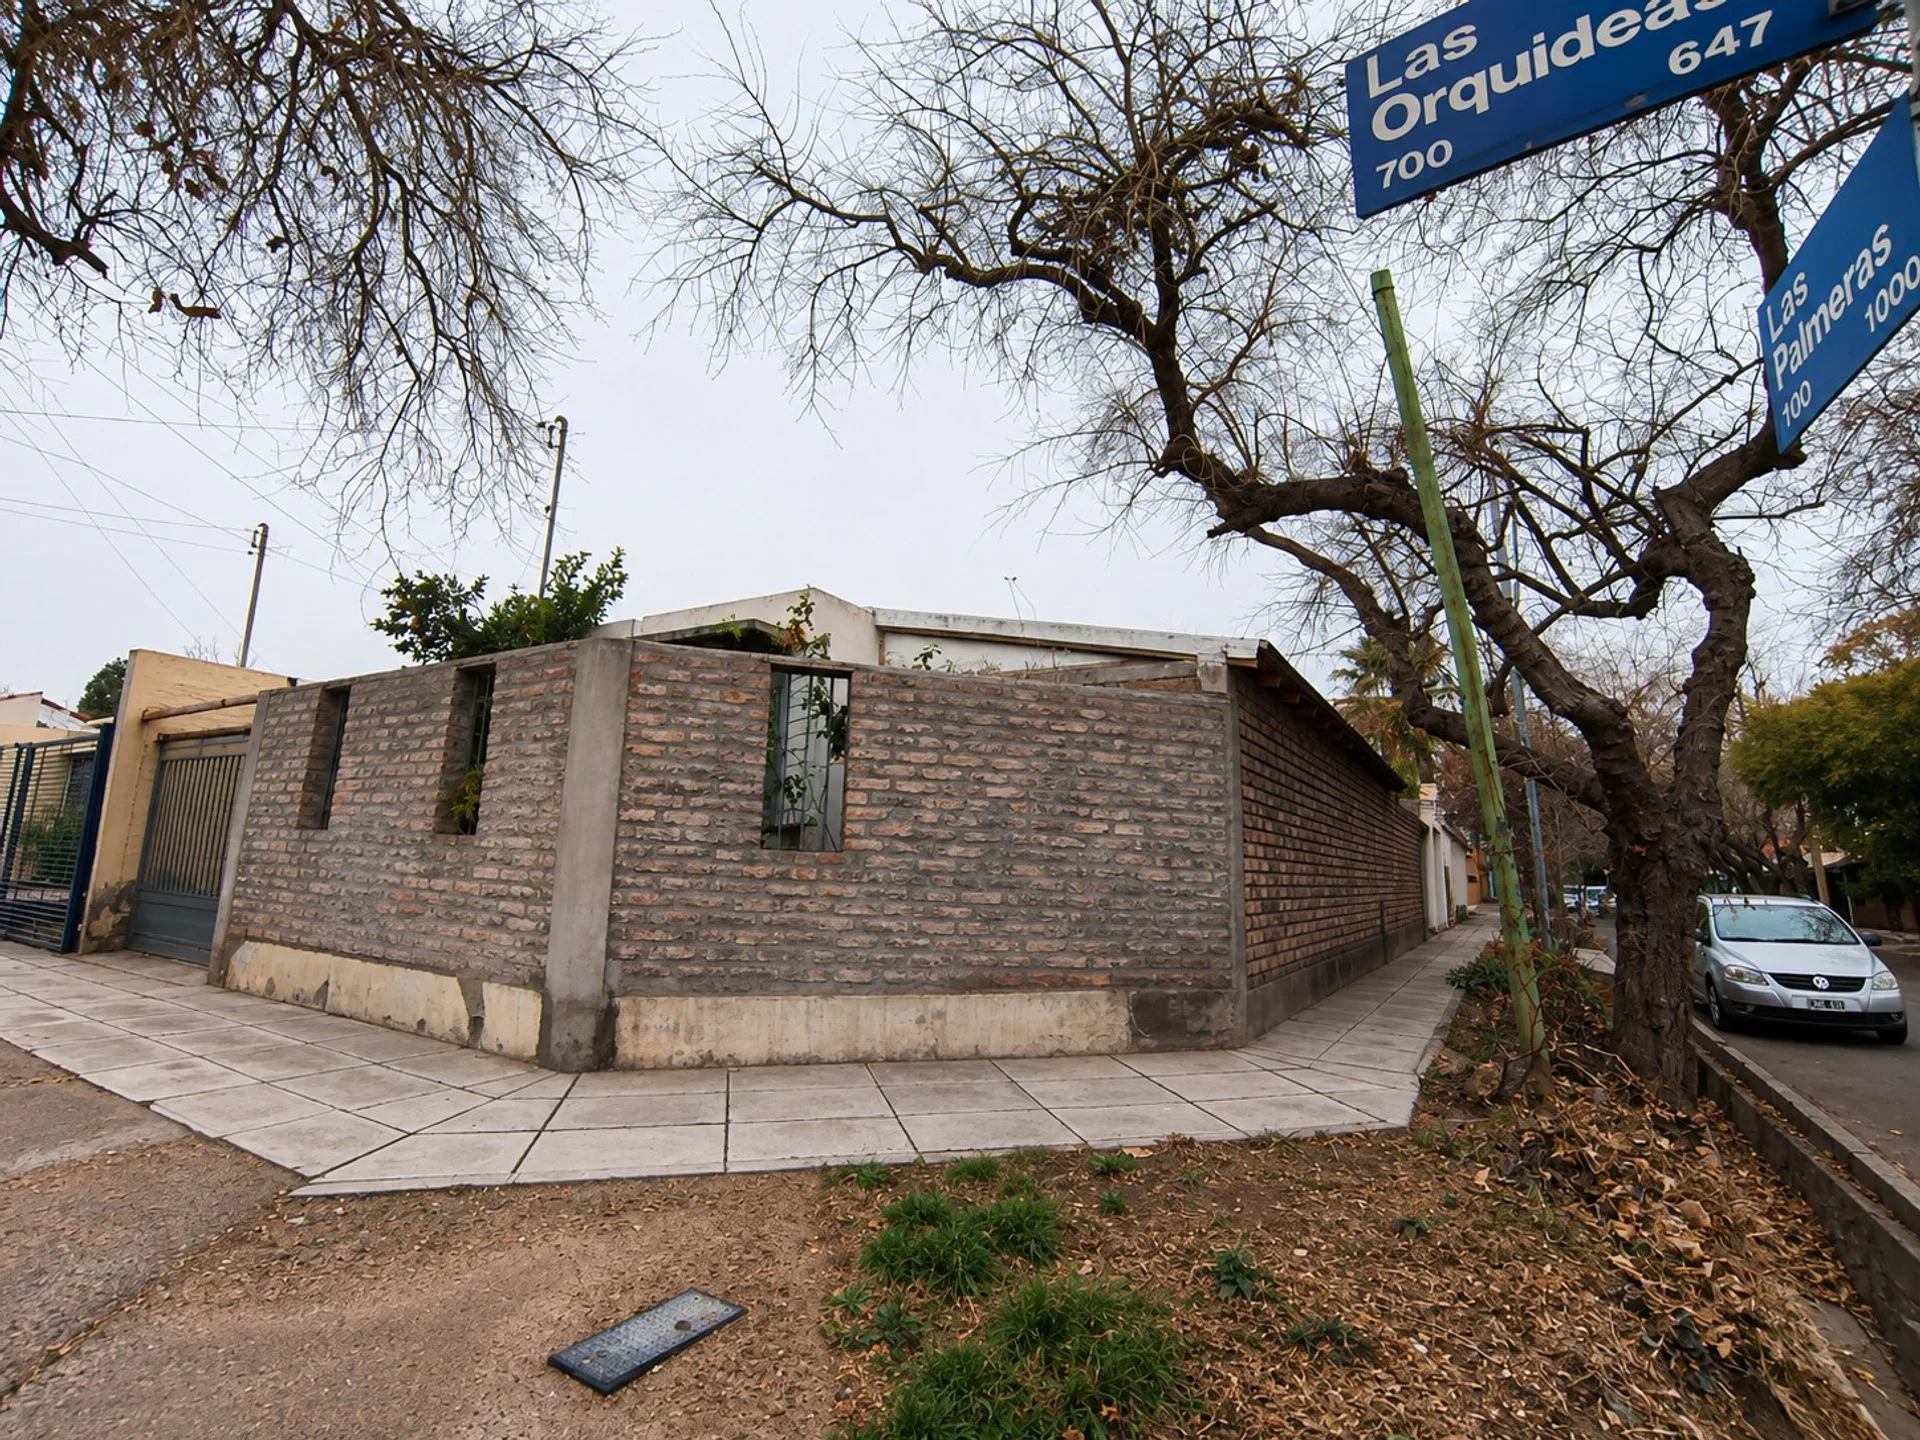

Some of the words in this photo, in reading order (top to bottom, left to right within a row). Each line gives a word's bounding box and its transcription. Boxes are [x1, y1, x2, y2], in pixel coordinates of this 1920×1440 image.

[1366, 24, 1478, 99] Las
[1372, 0, 1727, 142] Orquidea
[1668, 9, 1773, 76] 647
[1376, 139, 1453, 190] 700
[1766, 271, 1808, 344] Las
[1772, 223, 1892, 392] Palmeras
[1864, 255, 1920, 333] 1000
[1782, 380, 1812, 428] 100
